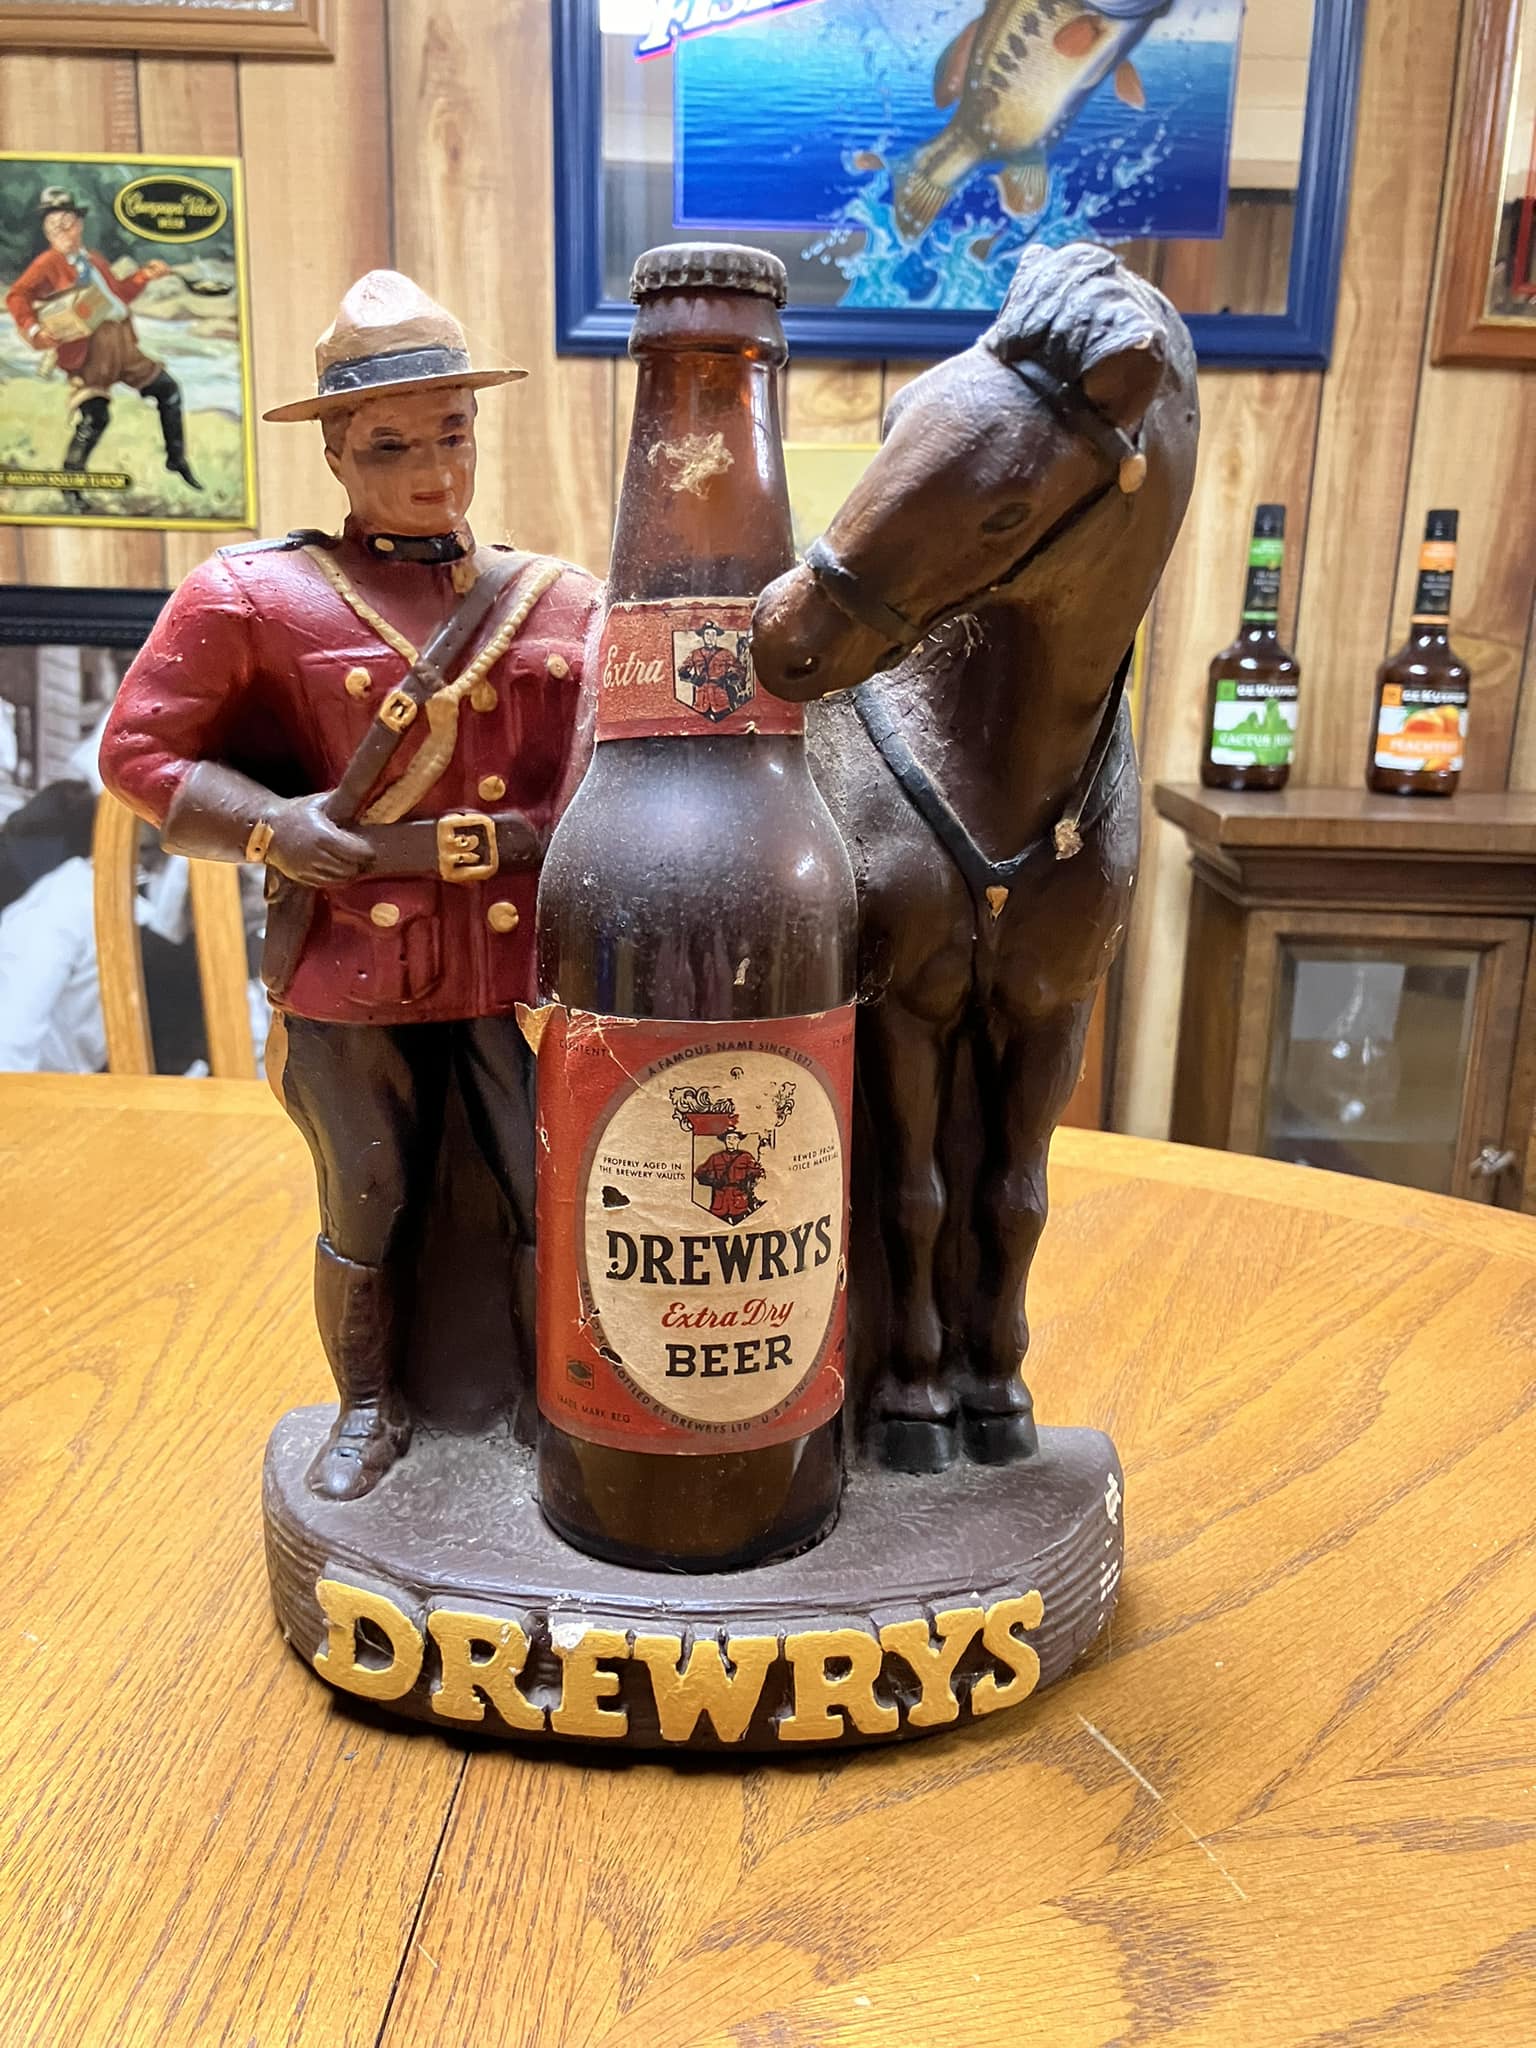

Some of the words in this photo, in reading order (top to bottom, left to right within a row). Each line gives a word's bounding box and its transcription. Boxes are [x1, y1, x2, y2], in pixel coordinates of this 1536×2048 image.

[602, 644, 664, 689] Extra
[647, 1066, 657, 1078] A
[657, 1044, 711, 1071] FAMOUS
[716, 1040, 754, 1051] NAME
[758, 1041, 794, 1056] SINCE
[599, 1164, 612, 1175] THE
[616, 1168, 653, 1179] BREWERY
[656, 1172, 687, 1181] VAULTS
[603, 1156, 640, 1168] PROPERLY
[643, 1161, 668, 1171] AGED
[671, 1162, 683, 1171] IN
[605, 1214, 832, 1286] DREWRYS
[660, 1301, 739, 1329] Extra
[740, 1297, 795, 1328] Dry
[664, 1334, 794, 1378] BEER
[670, 1413, 727, 1434] DREWRYS
[312, 1577, 1046, 1743] DREWRYS
